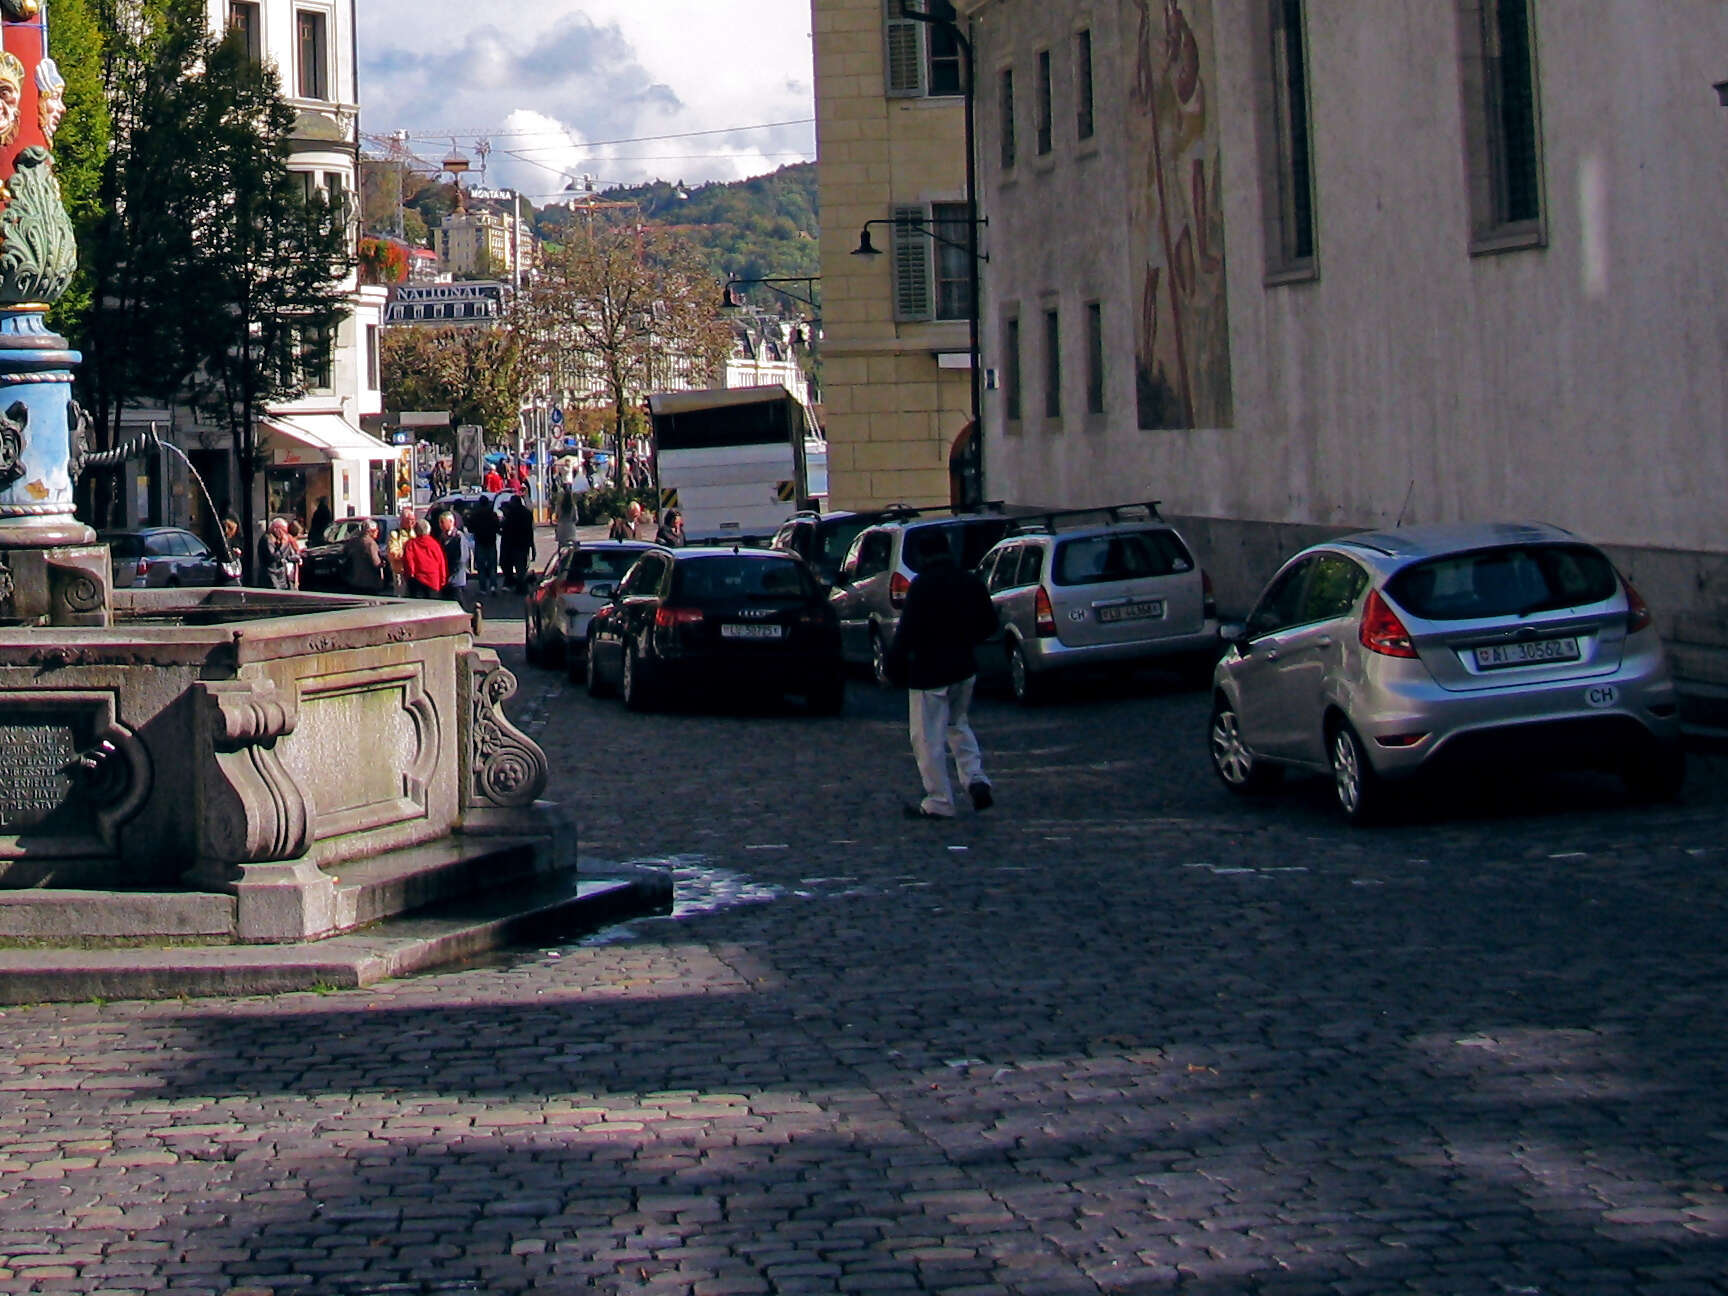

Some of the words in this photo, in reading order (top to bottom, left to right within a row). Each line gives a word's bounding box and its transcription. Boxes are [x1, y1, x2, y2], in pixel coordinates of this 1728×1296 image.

[470, 189, 512, 201] MONTANA
[396, 285, 487, 302] NATIONAL
[1070, 610, 1085, 621] CH
[1518, 641, 1563, 660] 30562
[1589, 687, 1613, 704] CH
